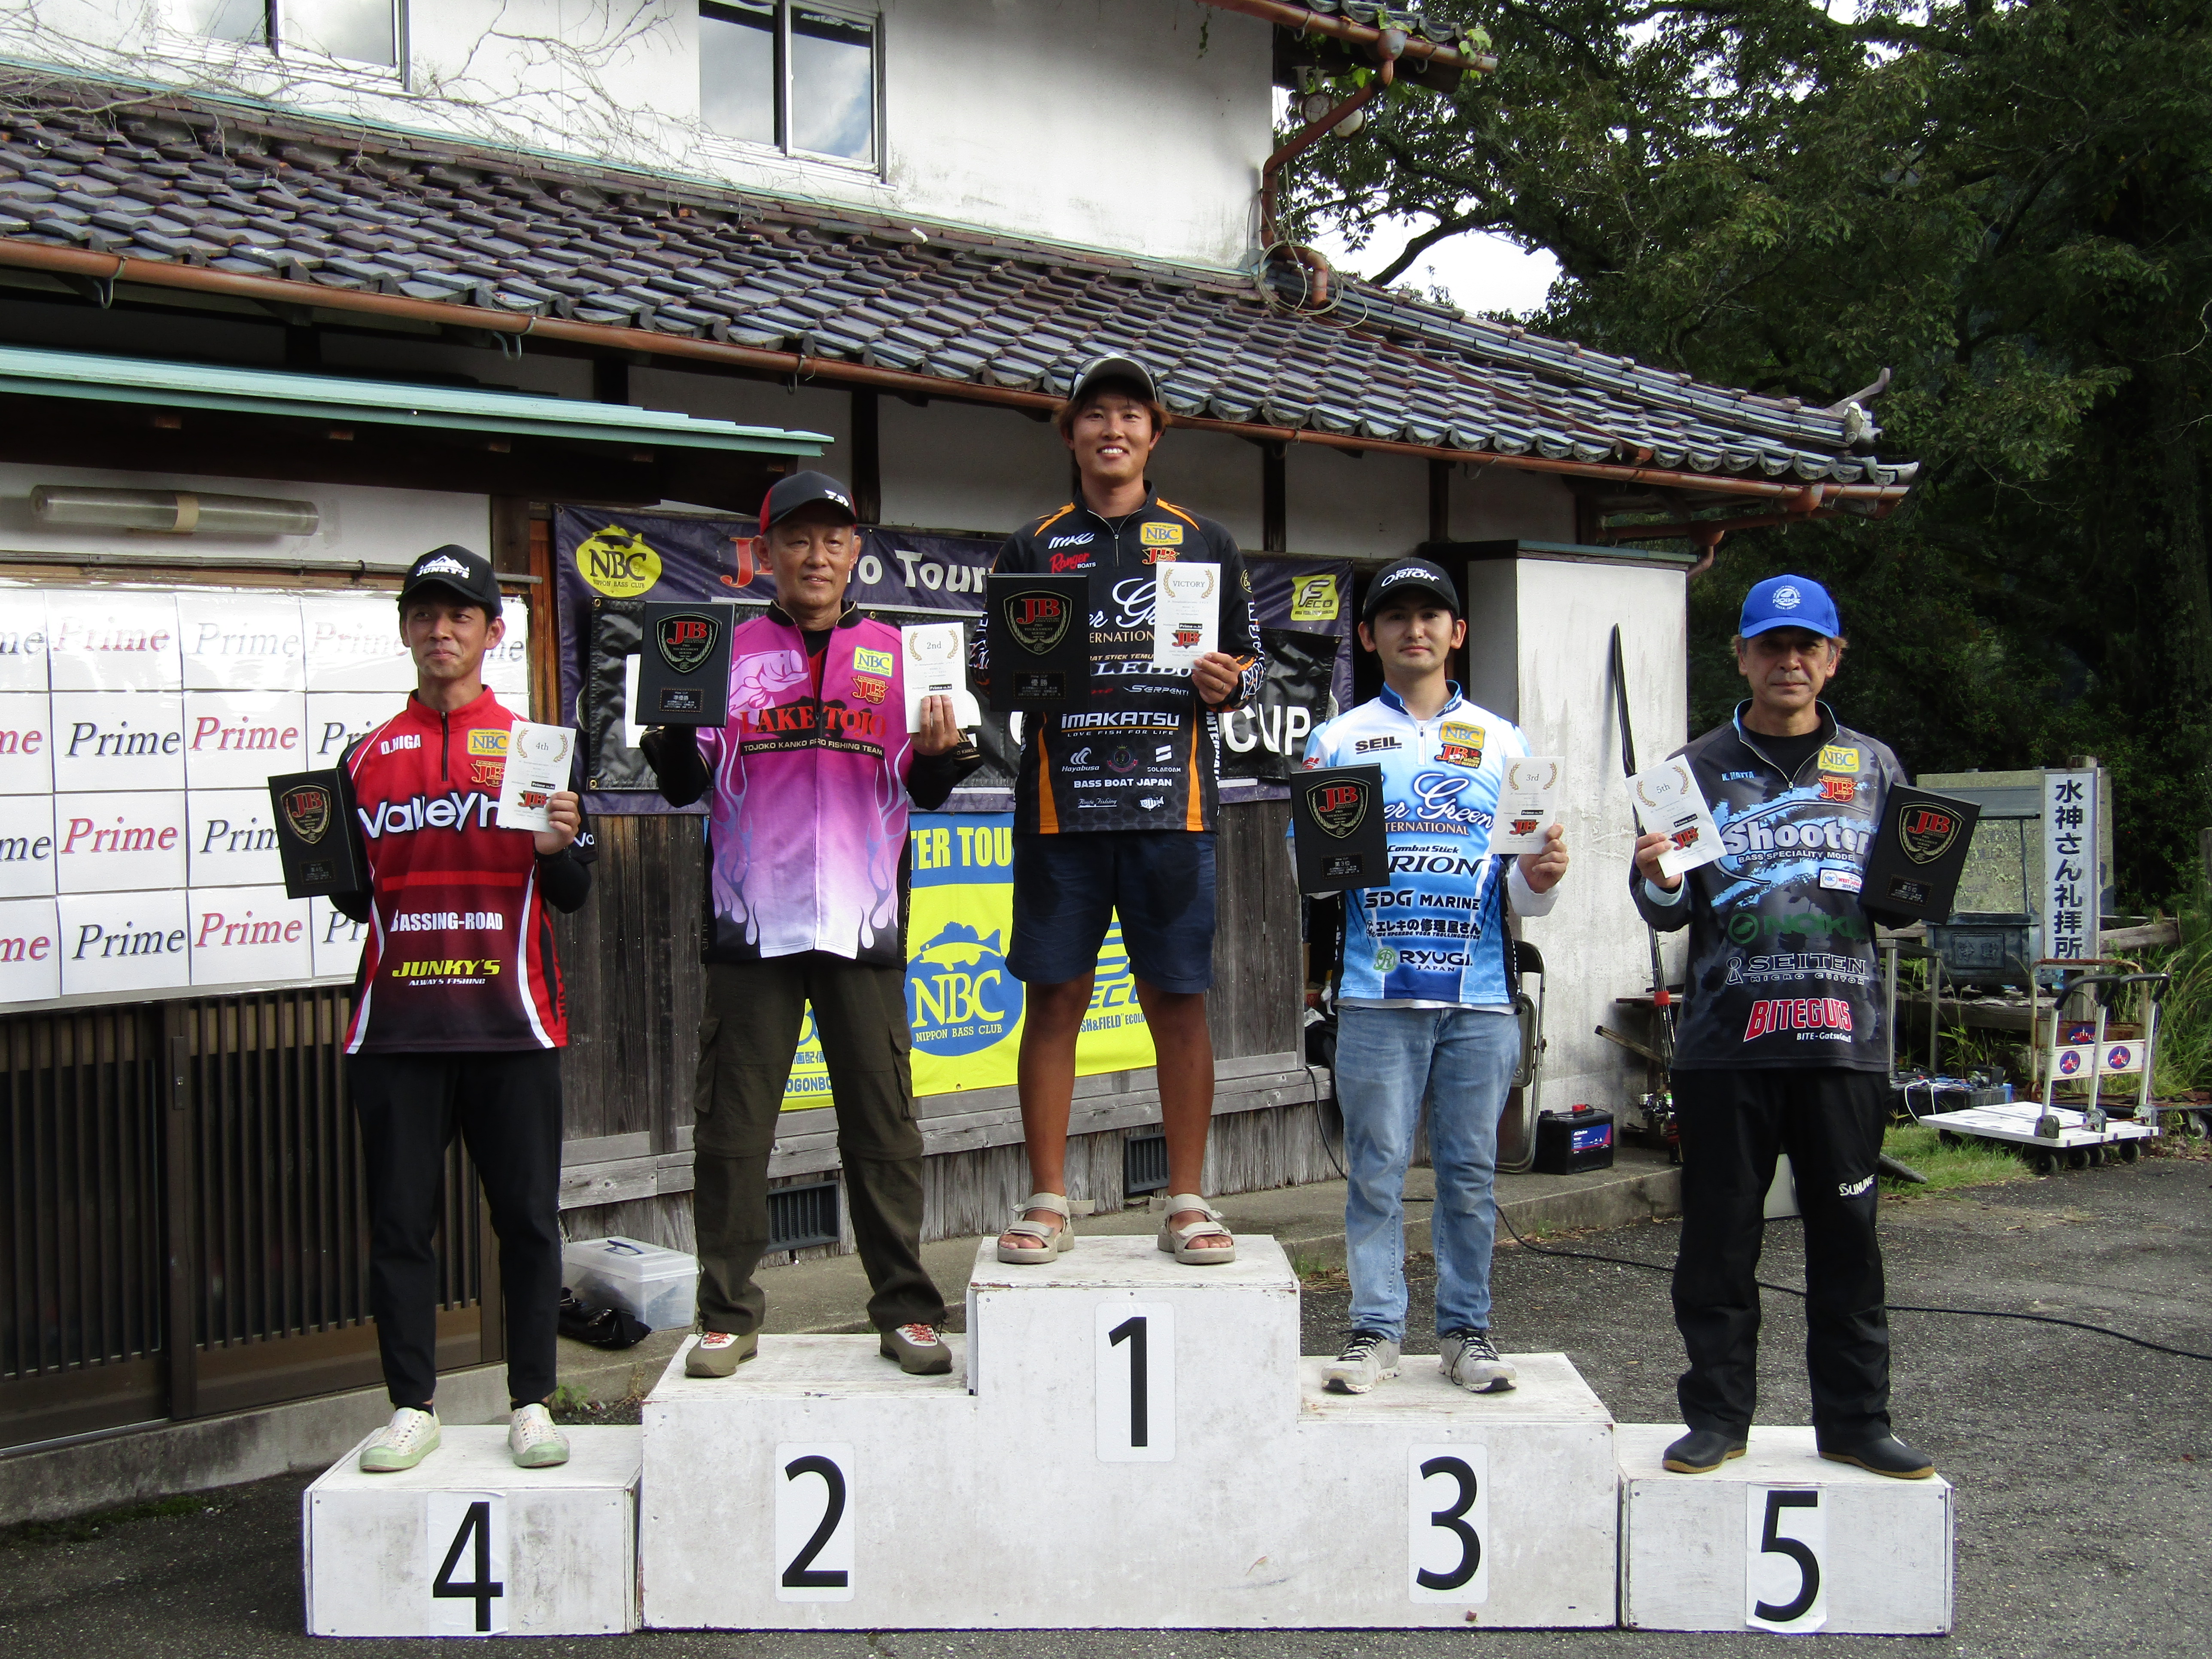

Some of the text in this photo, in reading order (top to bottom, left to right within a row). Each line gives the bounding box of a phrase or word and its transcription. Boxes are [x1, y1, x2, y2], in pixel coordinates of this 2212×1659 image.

[1145, 527, 1179, 540] NBC
[416, 565, 470, 579] JUNKY'S
[588, 549, 647, 580] NBC
[1049, 553, 1091, 574] Ranger
[1381, 570, 1440, 587] ORION
[1016, 598, 1061, 625] JB
[52, 617, 171, 651] Prime
[195, 621, 300, 657] Prime
[666, 621, 707, 644] JB
[1171, 632, 1199, 647] JB
[927, 641, 942, 650] 2nd
[857, 652, 890, 670] NBC
[852, 681, 886, 699] JB
[740, 705, 887, 738] LAKE TOJO
[1223, 703, 1310, 756] CUP
[64, 721, 182, 758] Prime
[188, 716, 299, 751] Prime
[472, 735, 507, 750] NBC
[1355, 735, 1402, 751] SEIL
[1444, 725, 1481, 743] NBC
[380, 734, 422, 756] D.HIGA
[535, 742, 549, 751] 4th
[744, 742, 776, 752] TOJOKO
[778, 740, 808, 748] KANKO
[828, 740, 860, 750] FISHING
[863, 745, 883, 756] TEAM
[1821, 749, 1856, 766] NBC
[1074, 778, 1173, 789] BASS BOAT JAPAN
[1656, 783, 1671, 794] 5th
[1820, 781, 1853, 798] JB
[292, 791, 323, 818] JB
[518, 793, 547, 807] JB
[1319, 786, 1358, 812] JB
[1414, 773, 1494, 829] Green
[1509, 821, 1537, 835] JB
[1906, 810, 1951, 834] JB
[61, 816, 179, 855] Prime
[1673, 828, 1699, 851] JB
[1720, 820, 1870, 855] Shooter
[1431, 845, 1459, 854] Stick
[1738, 850, 1824, 864] BASS SPECIALITY
[2054, 779, 2084, 959] 水神さん礼拝所
[1364, 890, 1481, 910] SDG MARINE
[194, 910, 303, 949] Prime
[1376, 918, 1481, 936] エレキの修理屋さん
[71, 921, 186, 961] Prime
[392, 959, 501, 978] JUNKY'S
[1747, 953, 1867, 975] SEITEN
[1750, 973, 1865, 985] MICRO CUSTOM
[911, 969, 1006, 1028] NBC
[1743, 997, 1853, 1043] BITEGUTS
[915, 1024, 1003, 1042] NIPPON BASS CLUB
[793, 1051, 826, 1065] 画配信
[1109, 1316, 1148, 1447] 1
[781, 1455, 848, 1587] 2
[1416, 1455, 1481, 1591] 3
[432, 1501, 504, 1632] 4
[1754, 1490, 1820, 1623] 5
